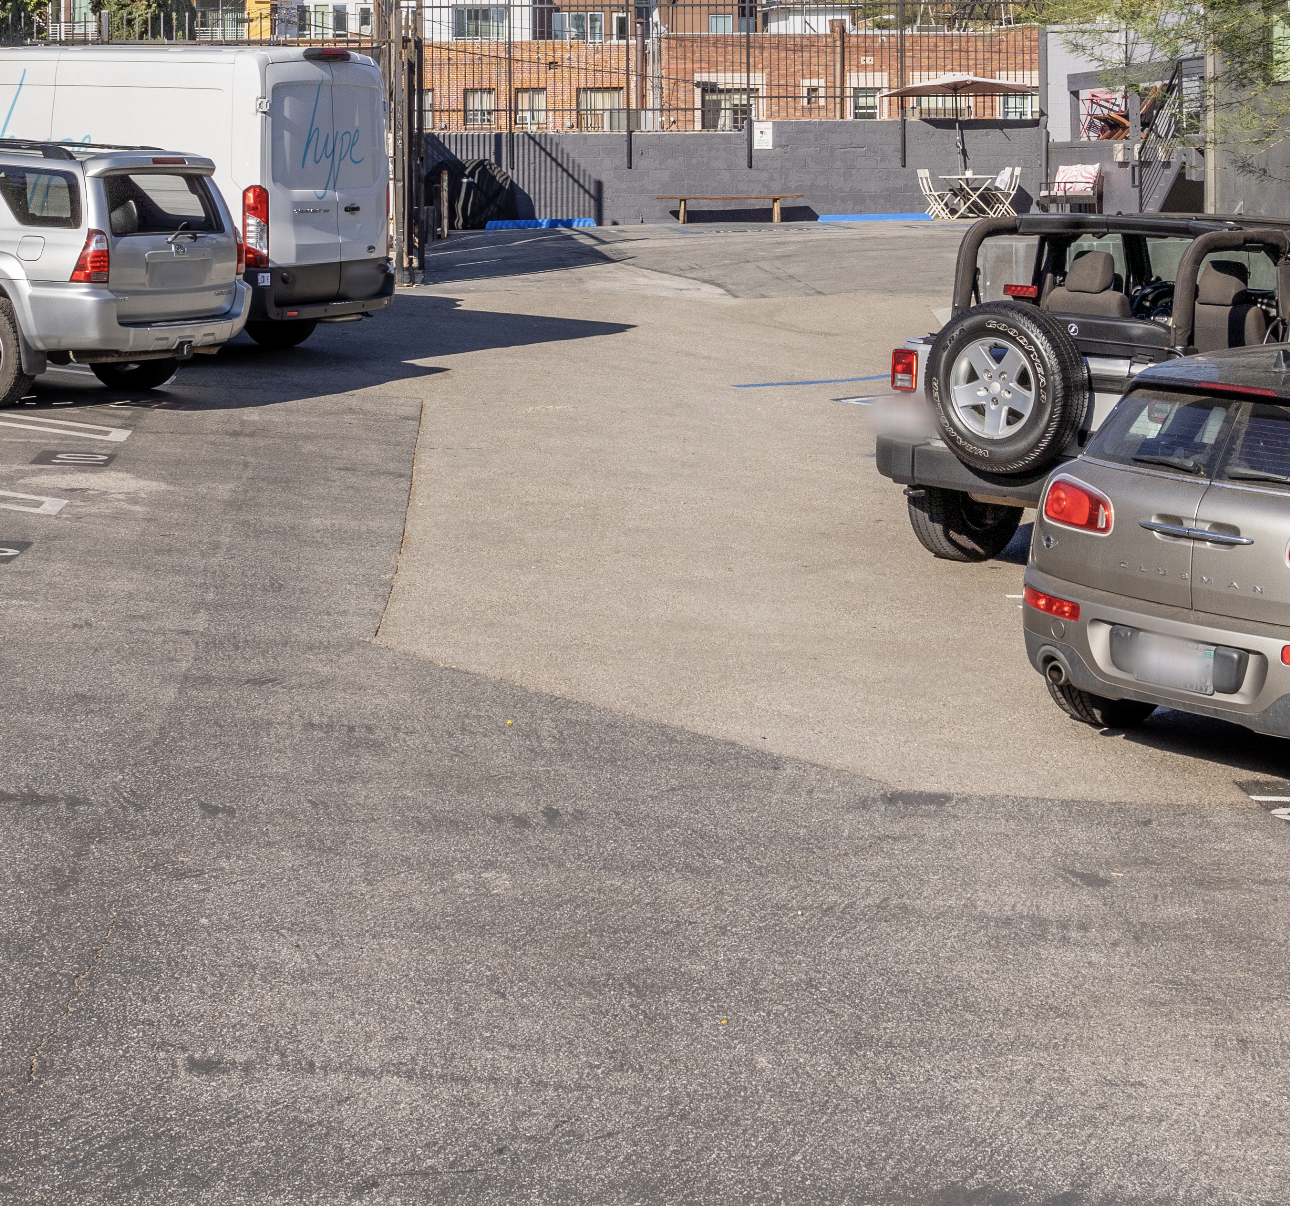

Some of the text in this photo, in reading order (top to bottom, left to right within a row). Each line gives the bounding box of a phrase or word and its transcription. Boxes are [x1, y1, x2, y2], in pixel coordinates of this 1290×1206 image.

[301, 75, 365, 200] hype
[985, 320, 1047, 404] GOODYEAR
[931, 377, 990, 458] WRANGLER
[51, 453, 109, 465] 10
[1119, 560, 1266, 595] CLUBMAN
